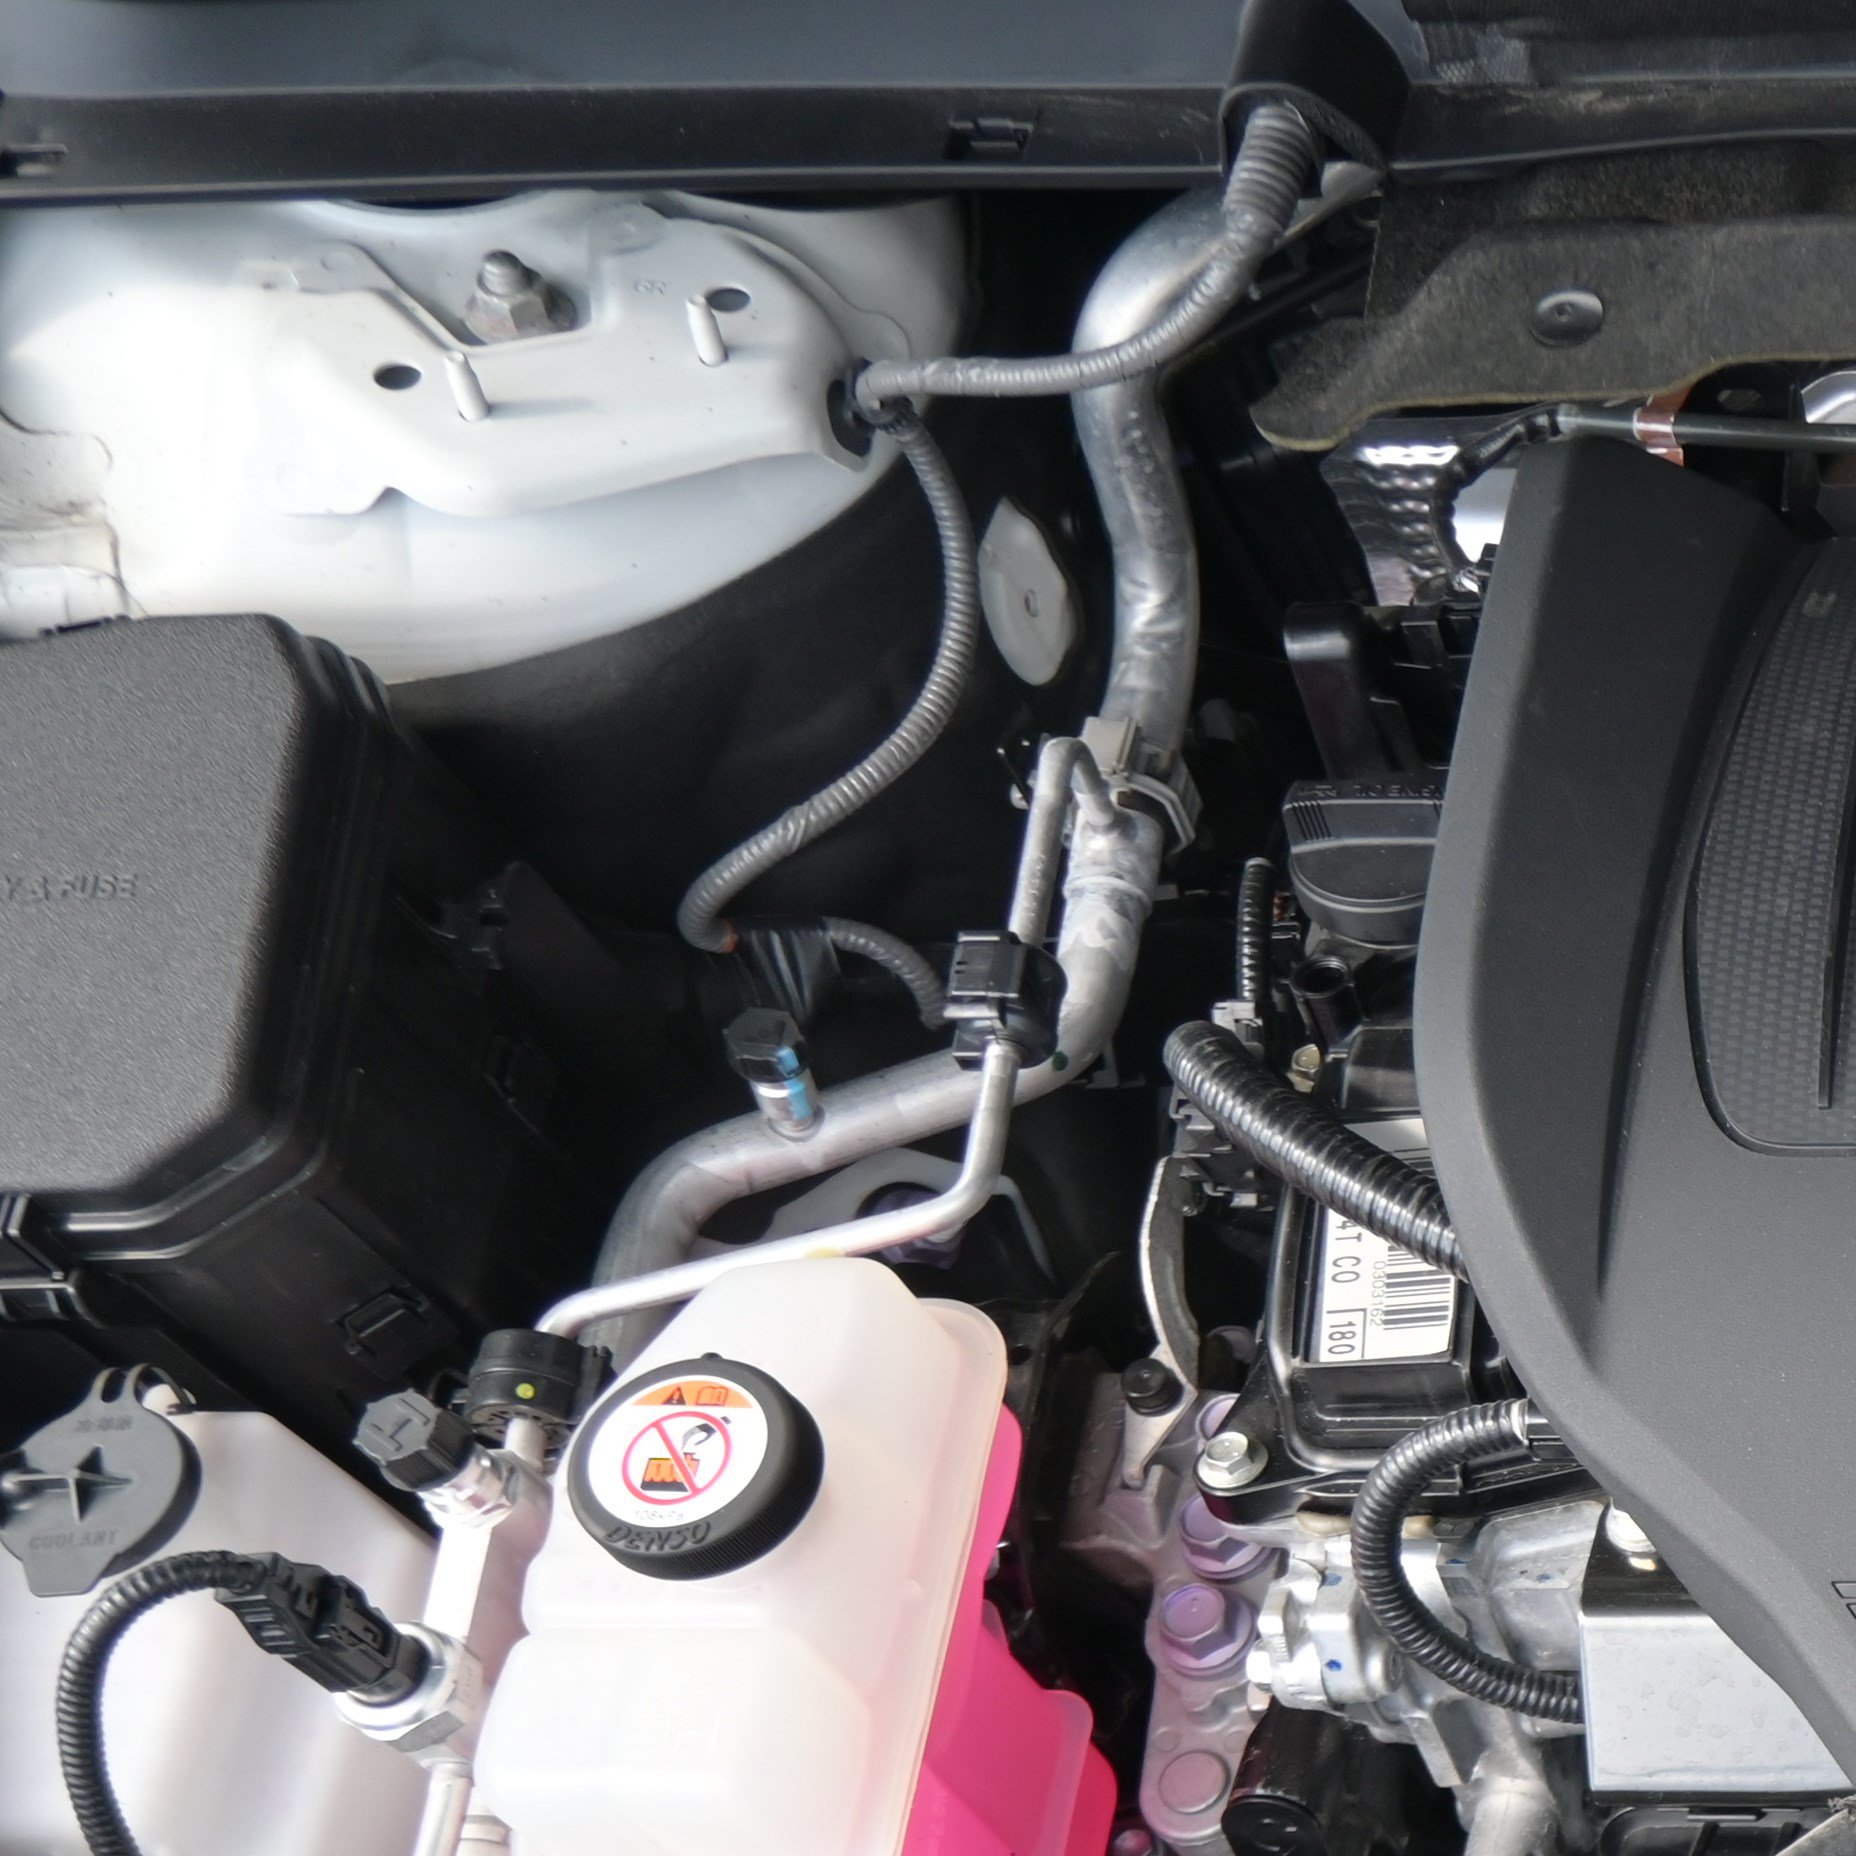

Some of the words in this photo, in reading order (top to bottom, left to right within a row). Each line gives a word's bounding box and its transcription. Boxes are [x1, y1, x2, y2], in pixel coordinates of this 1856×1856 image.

[1328, 1321, 1358, 1355] 180
[28, 1527, 119, 1550] COOLANT
[605, 1519, 712, 1552] DENSO
